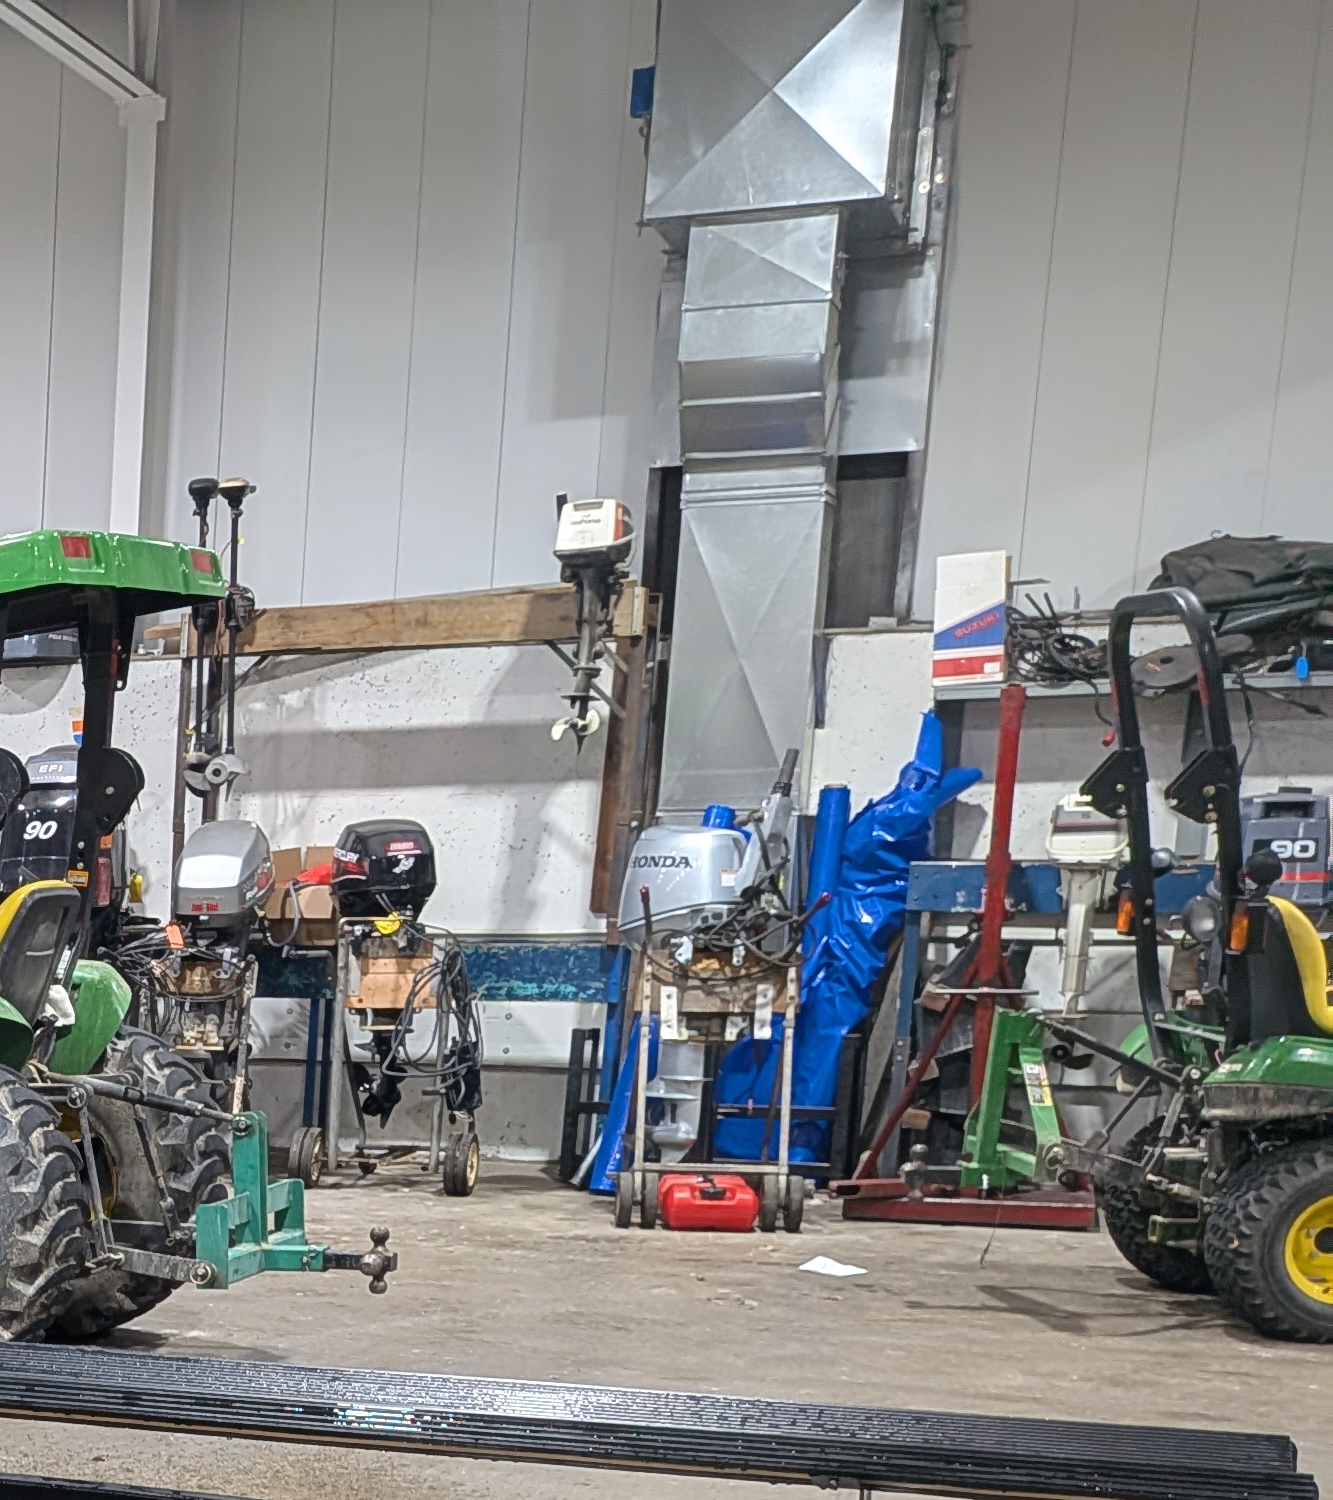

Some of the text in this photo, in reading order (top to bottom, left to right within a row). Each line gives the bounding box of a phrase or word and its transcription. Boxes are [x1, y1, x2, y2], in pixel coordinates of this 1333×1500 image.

[38, 764, 64, 774] EFI
[22, 820, 58, 840] 90
[1270, 839, 1316, 859] 90
[630, 855, 693, 869] HONDA
